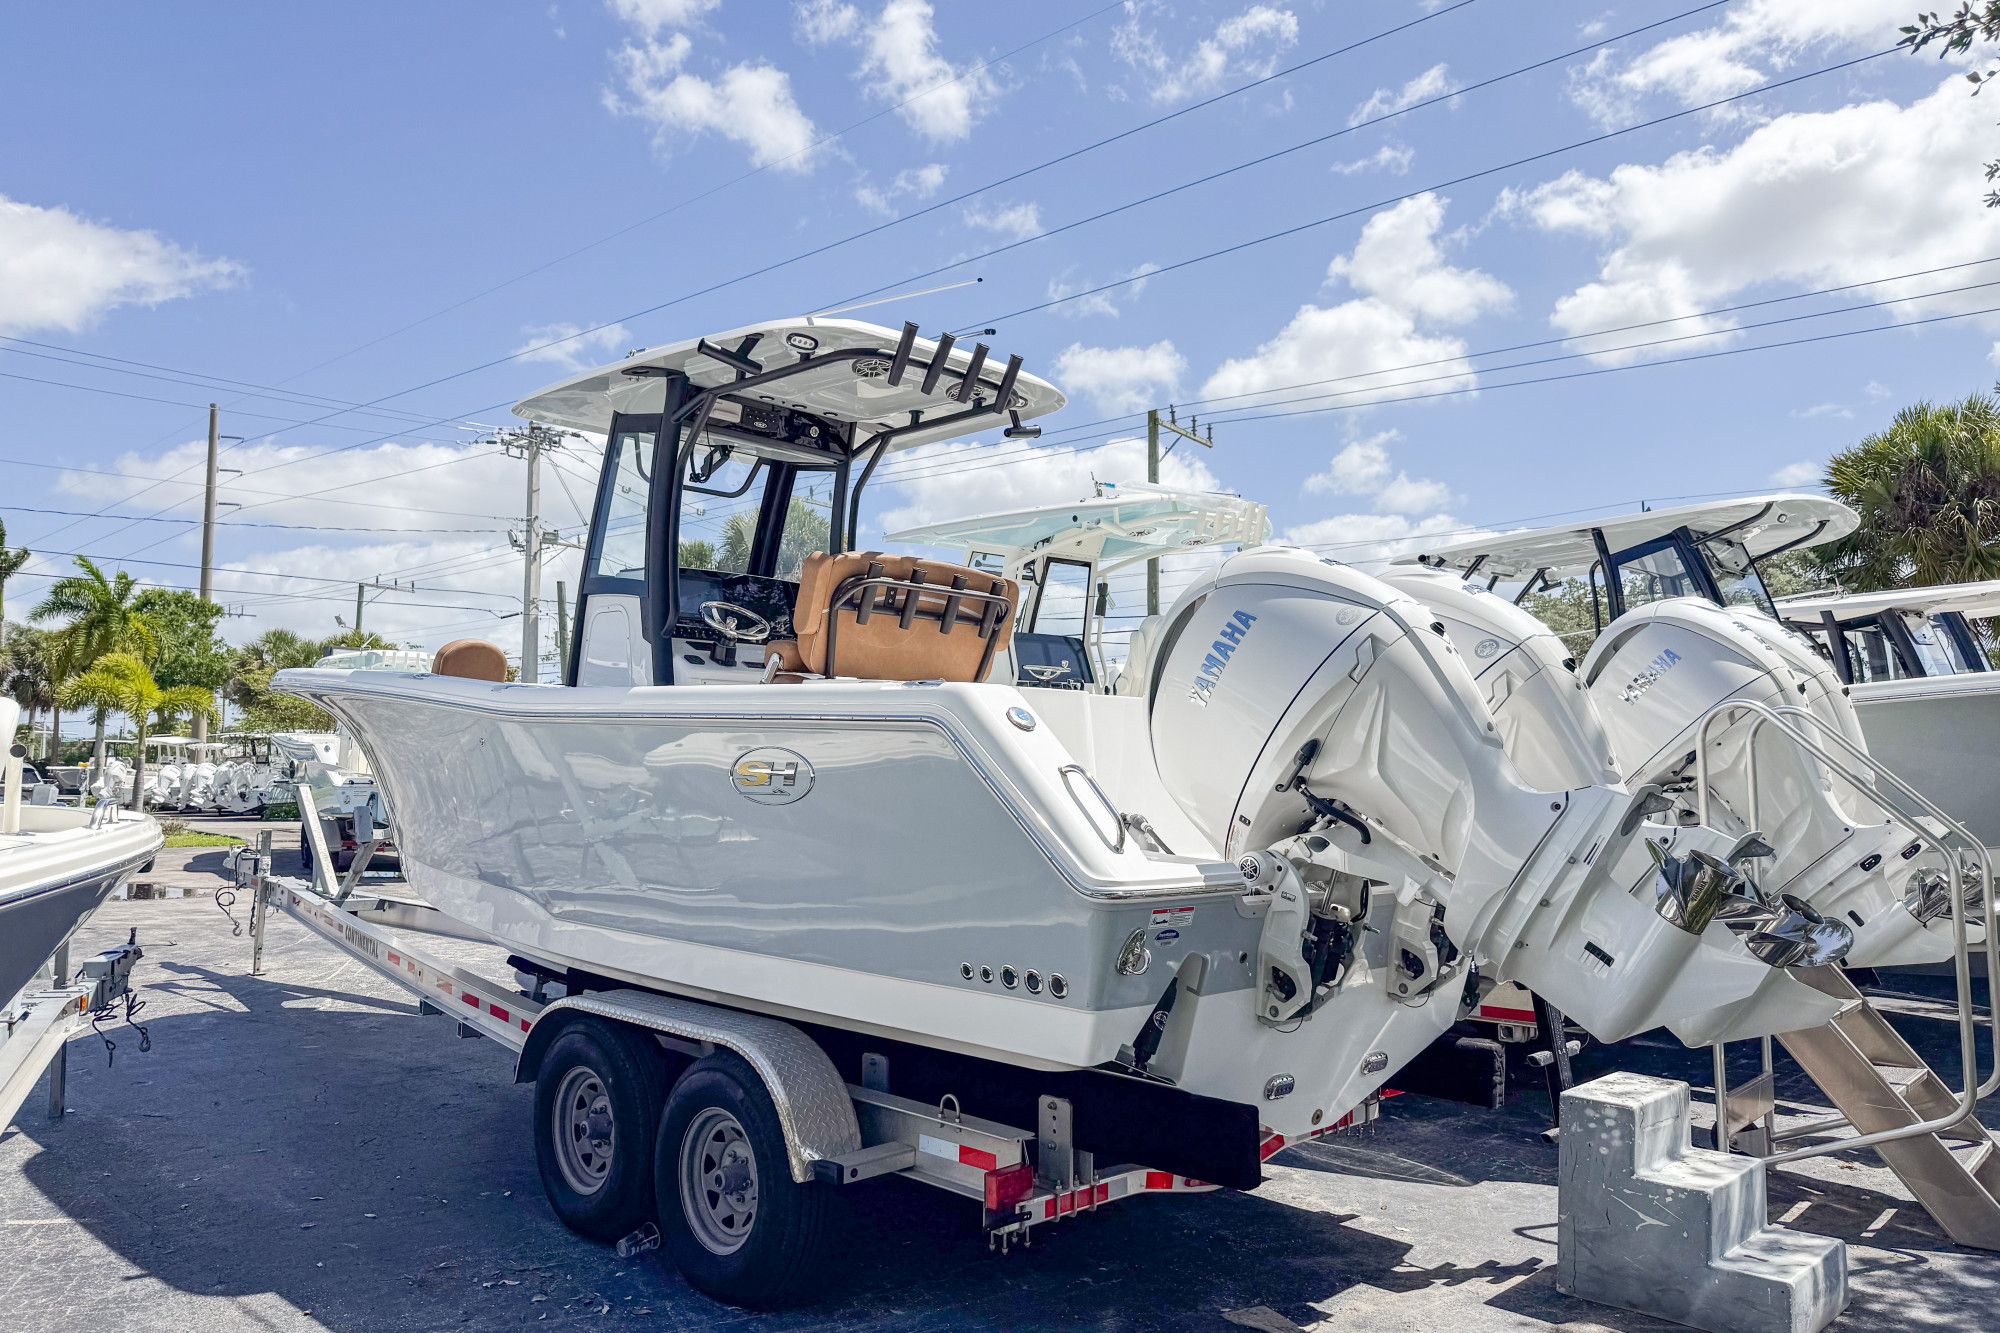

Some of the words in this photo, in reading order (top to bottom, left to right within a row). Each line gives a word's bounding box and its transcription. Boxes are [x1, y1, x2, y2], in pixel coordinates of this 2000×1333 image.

[1188, 609, 1258, 708] YAMAHA
[1617, 648, 1682, 705] YAMAHA
[345, 924, 379, 960] CONTINENTAL
